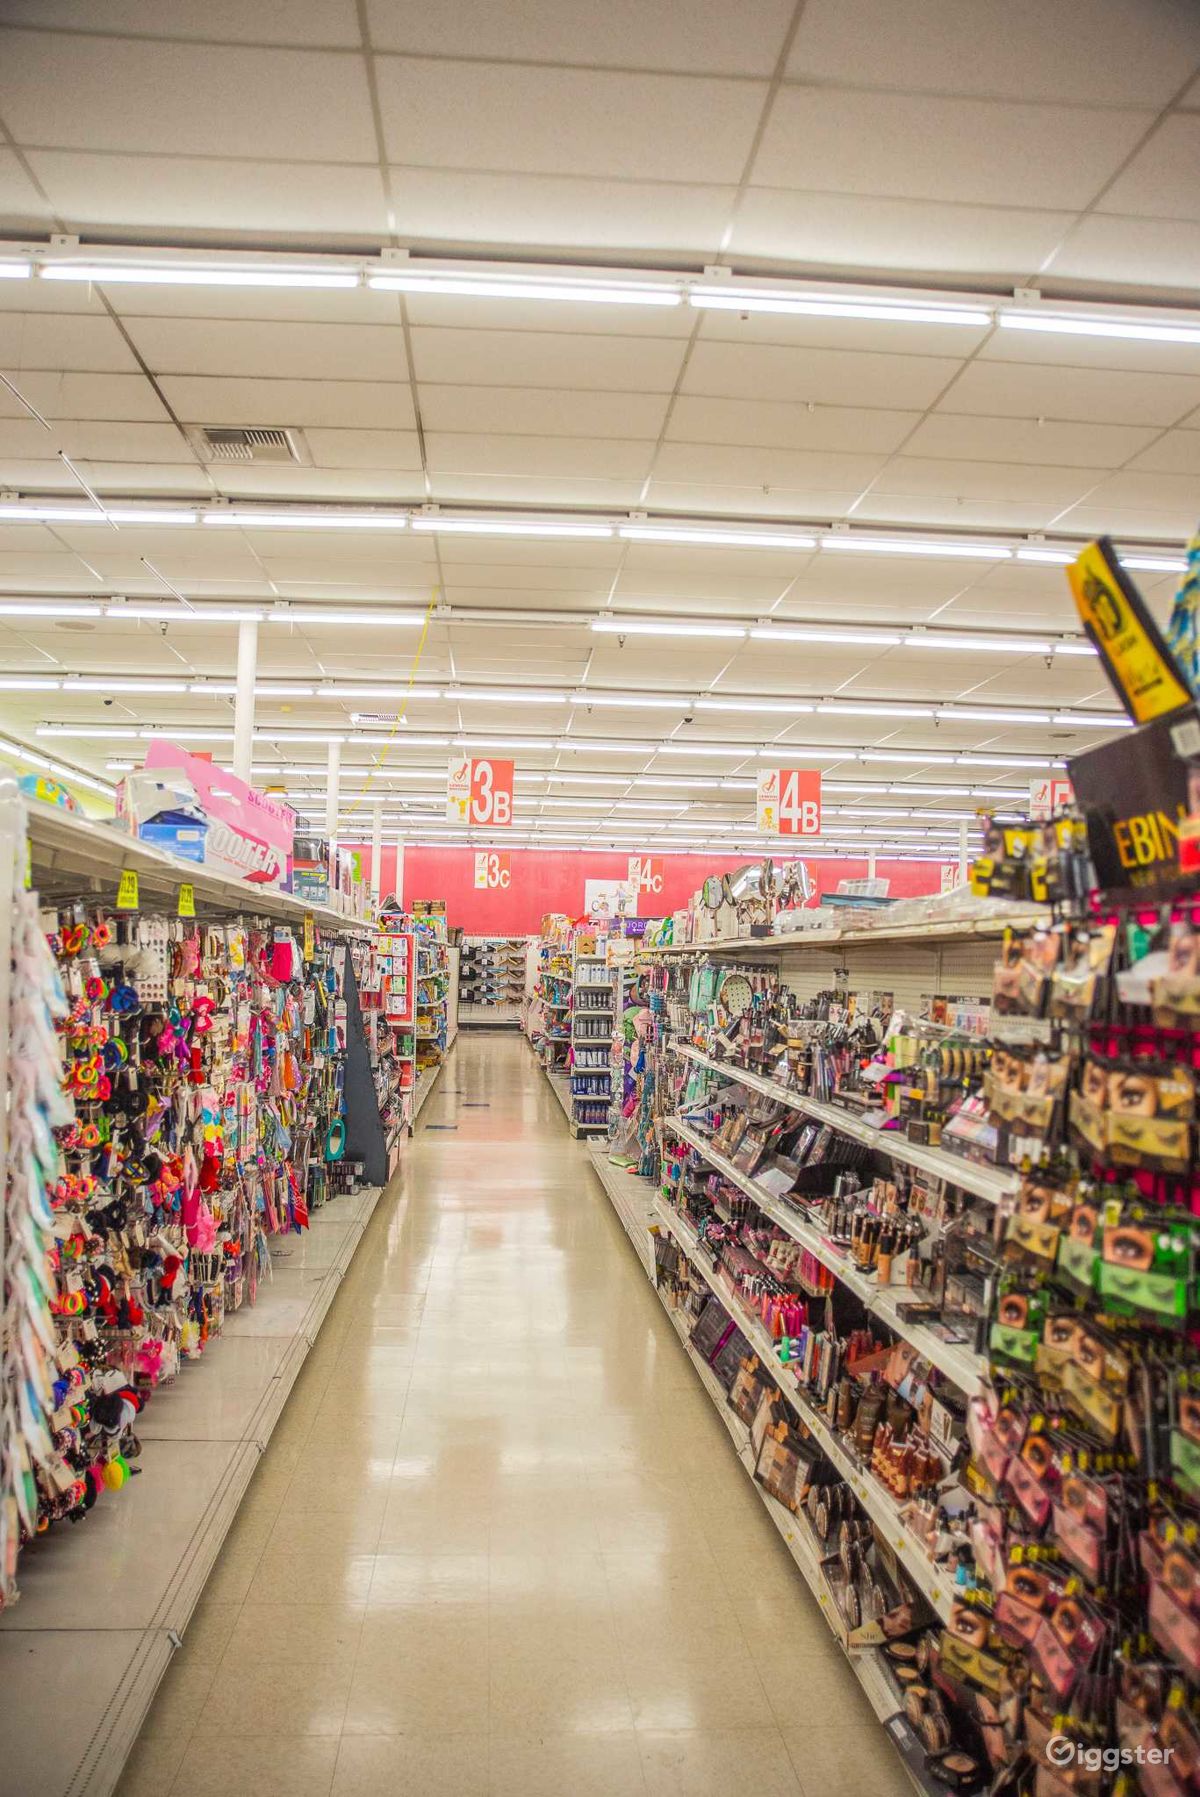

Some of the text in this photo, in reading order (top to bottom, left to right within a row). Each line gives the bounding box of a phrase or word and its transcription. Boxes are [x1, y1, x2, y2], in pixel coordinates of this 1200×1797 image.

[472, 760, 511, 823] 3B
[780, 771, 819, 833] 4B
[488, 853, 510, 888] 3C
[641, 858, 663, 893] 4C
